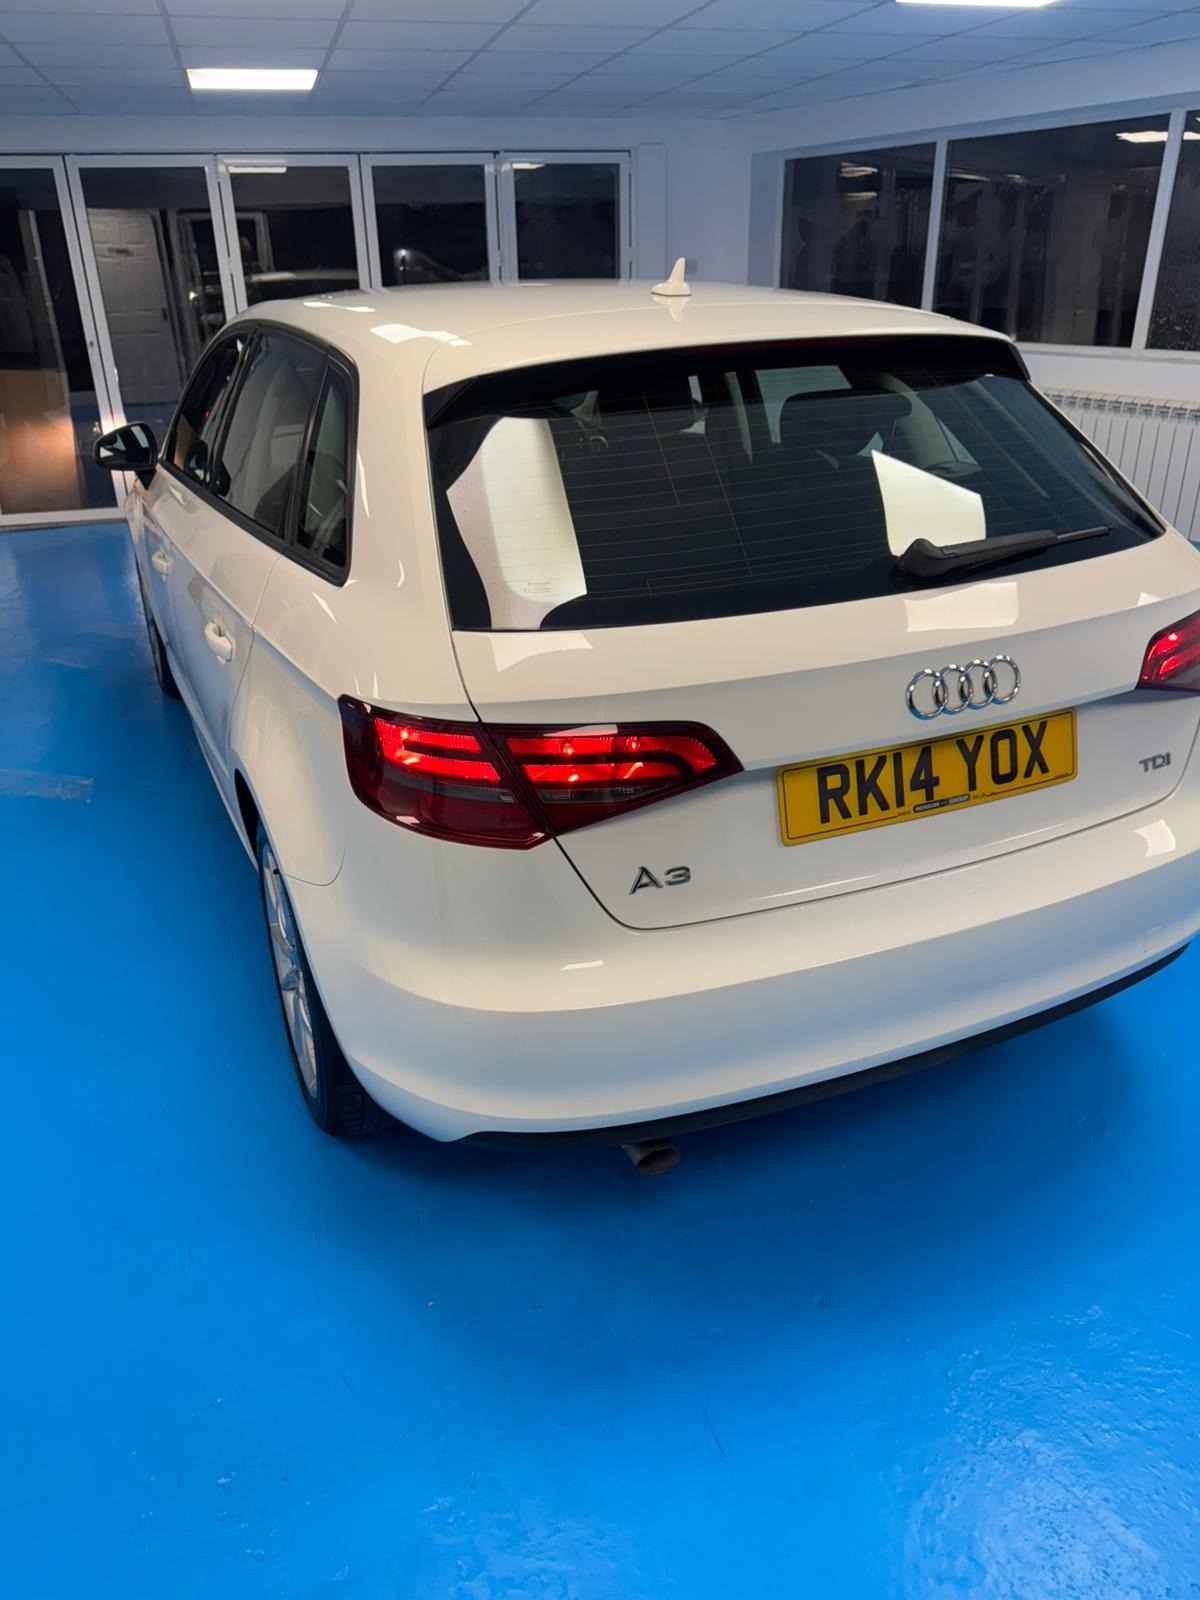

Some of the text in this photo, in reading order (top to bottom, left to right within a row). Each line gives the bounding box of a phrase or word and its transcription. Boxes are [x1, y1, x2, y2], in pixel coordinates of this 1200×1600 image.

[818, 720, 1049, 824] RK14 YOX
[1139, 751, 1171, 772] TDI
[629, 866, 691, 895] A3
